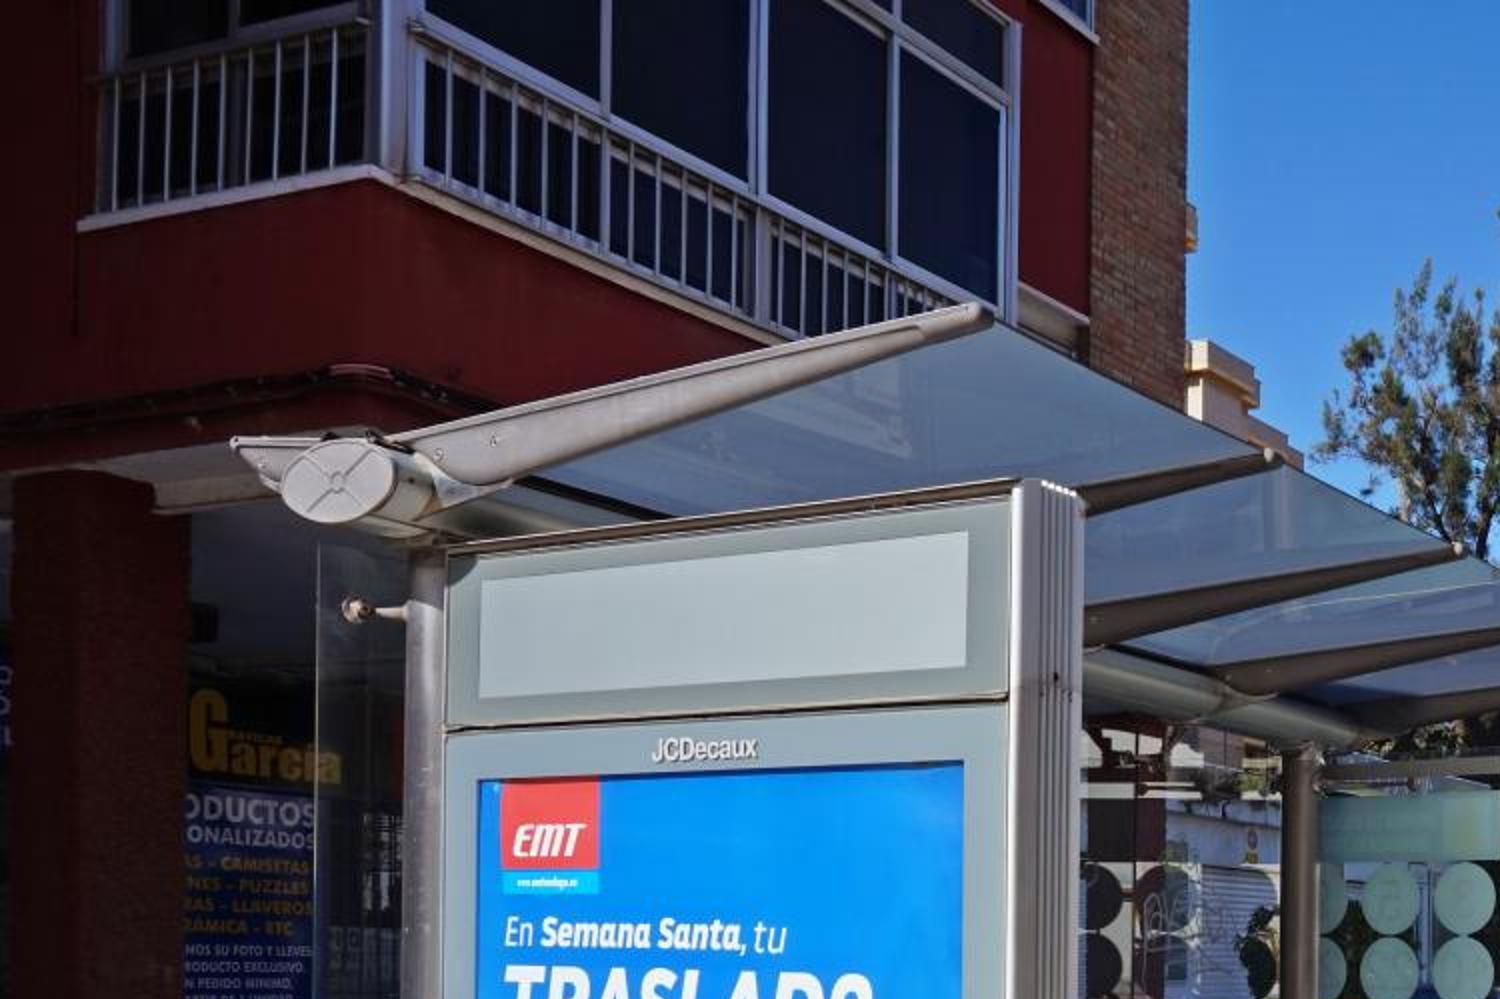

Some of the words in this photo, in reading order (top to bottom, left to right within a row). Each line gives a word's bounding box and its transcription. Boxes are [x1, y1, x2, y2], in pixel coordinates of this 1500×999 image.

[651, 737, 757, 763] JCDecaux
[513, 822, 587, 858] EMT
[505, 916, 533, 947] En
[541, 916, 651, 949] Semana
[658, 917, 747, 957] Santa,
[753, 920, 787, 954] tu
